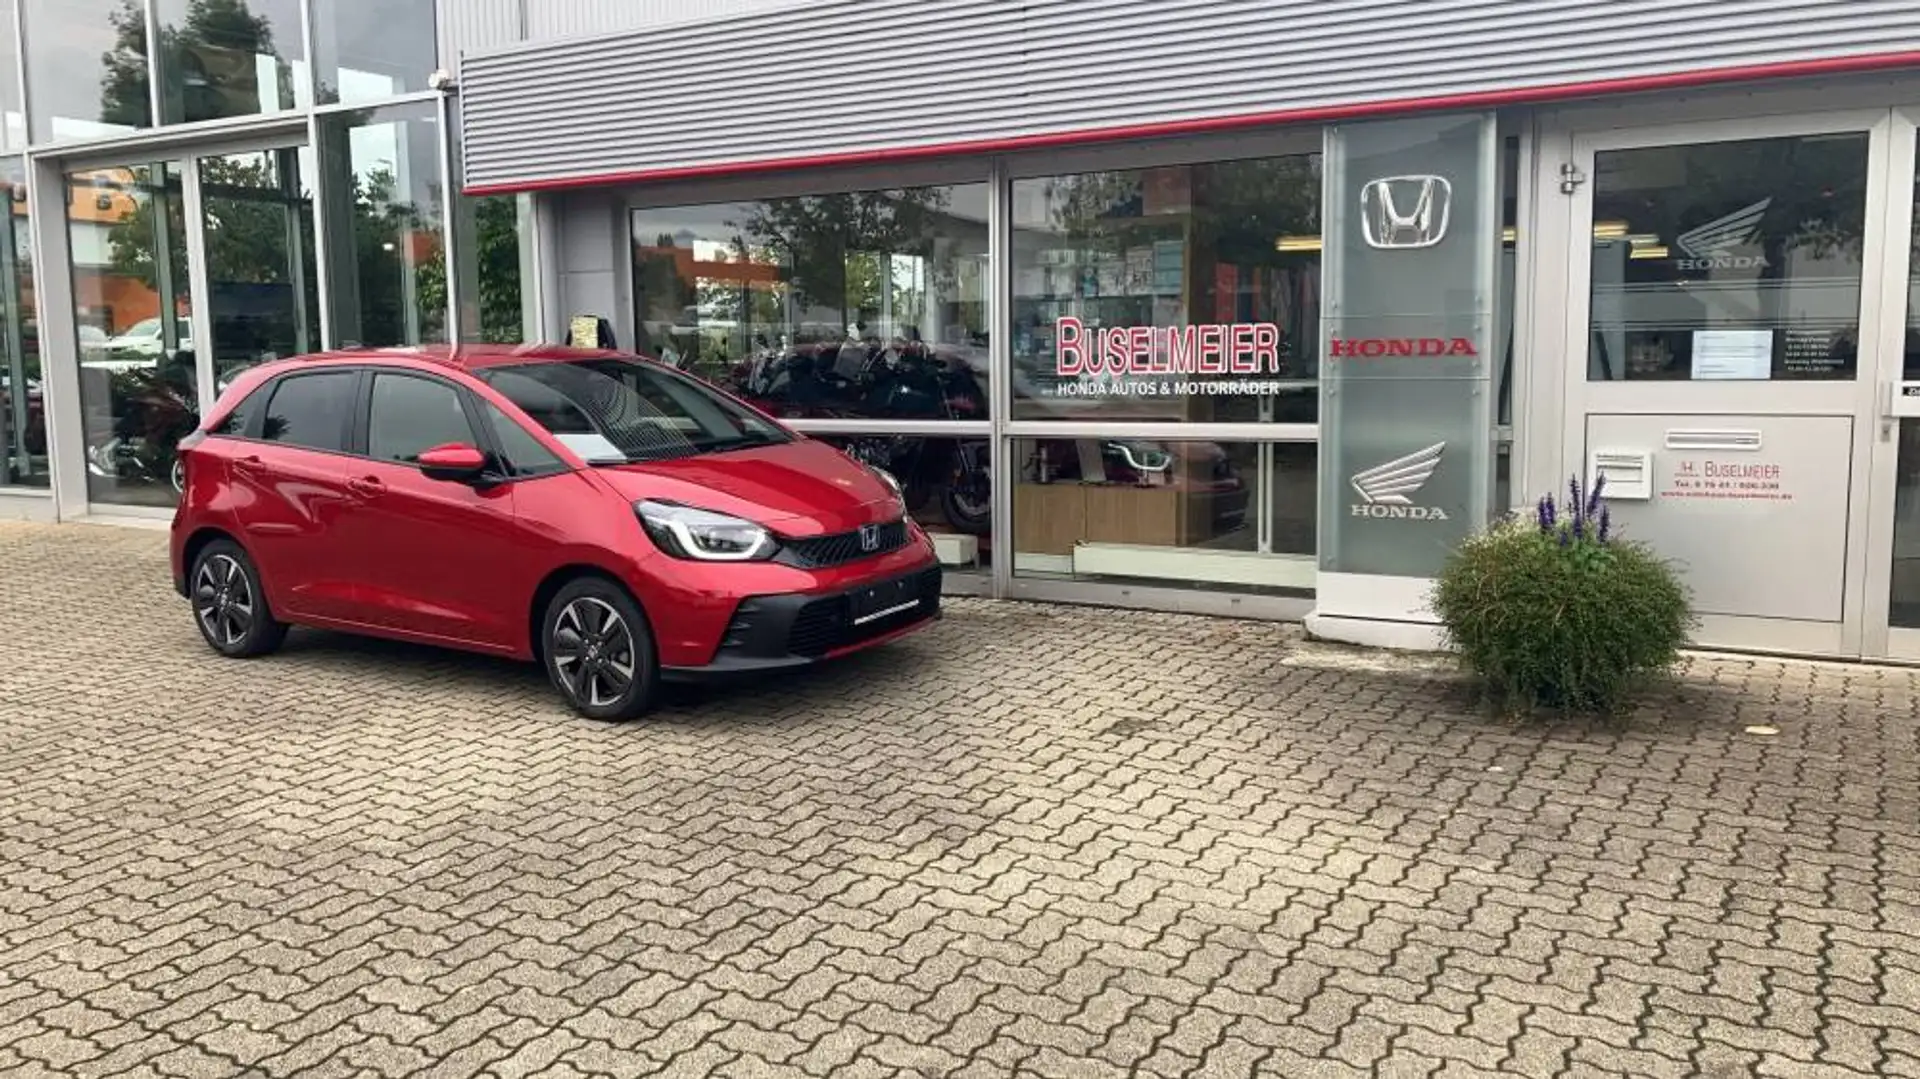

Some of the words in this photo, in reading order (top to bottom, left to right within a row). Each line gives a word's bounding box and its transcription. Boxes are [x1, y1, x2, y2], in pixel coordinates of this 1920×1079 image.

[1677, 256, 1770, 270] HONDA
[1056, 316, 1279, 376] BUSELMEIER
[1330, 338, 1478, 357] HONDA
[1057, 382, 1106, 396] HONDA
[1111, 382, 1157, 396] AUTOS
[1159, 382, 1171, 395] &
[1174, 379, 1279, 396] MOTORRÄDER
[1704, 460, 1780, 479] BUSELMEIER
[1351, 504, 1449, 520] HONDA
